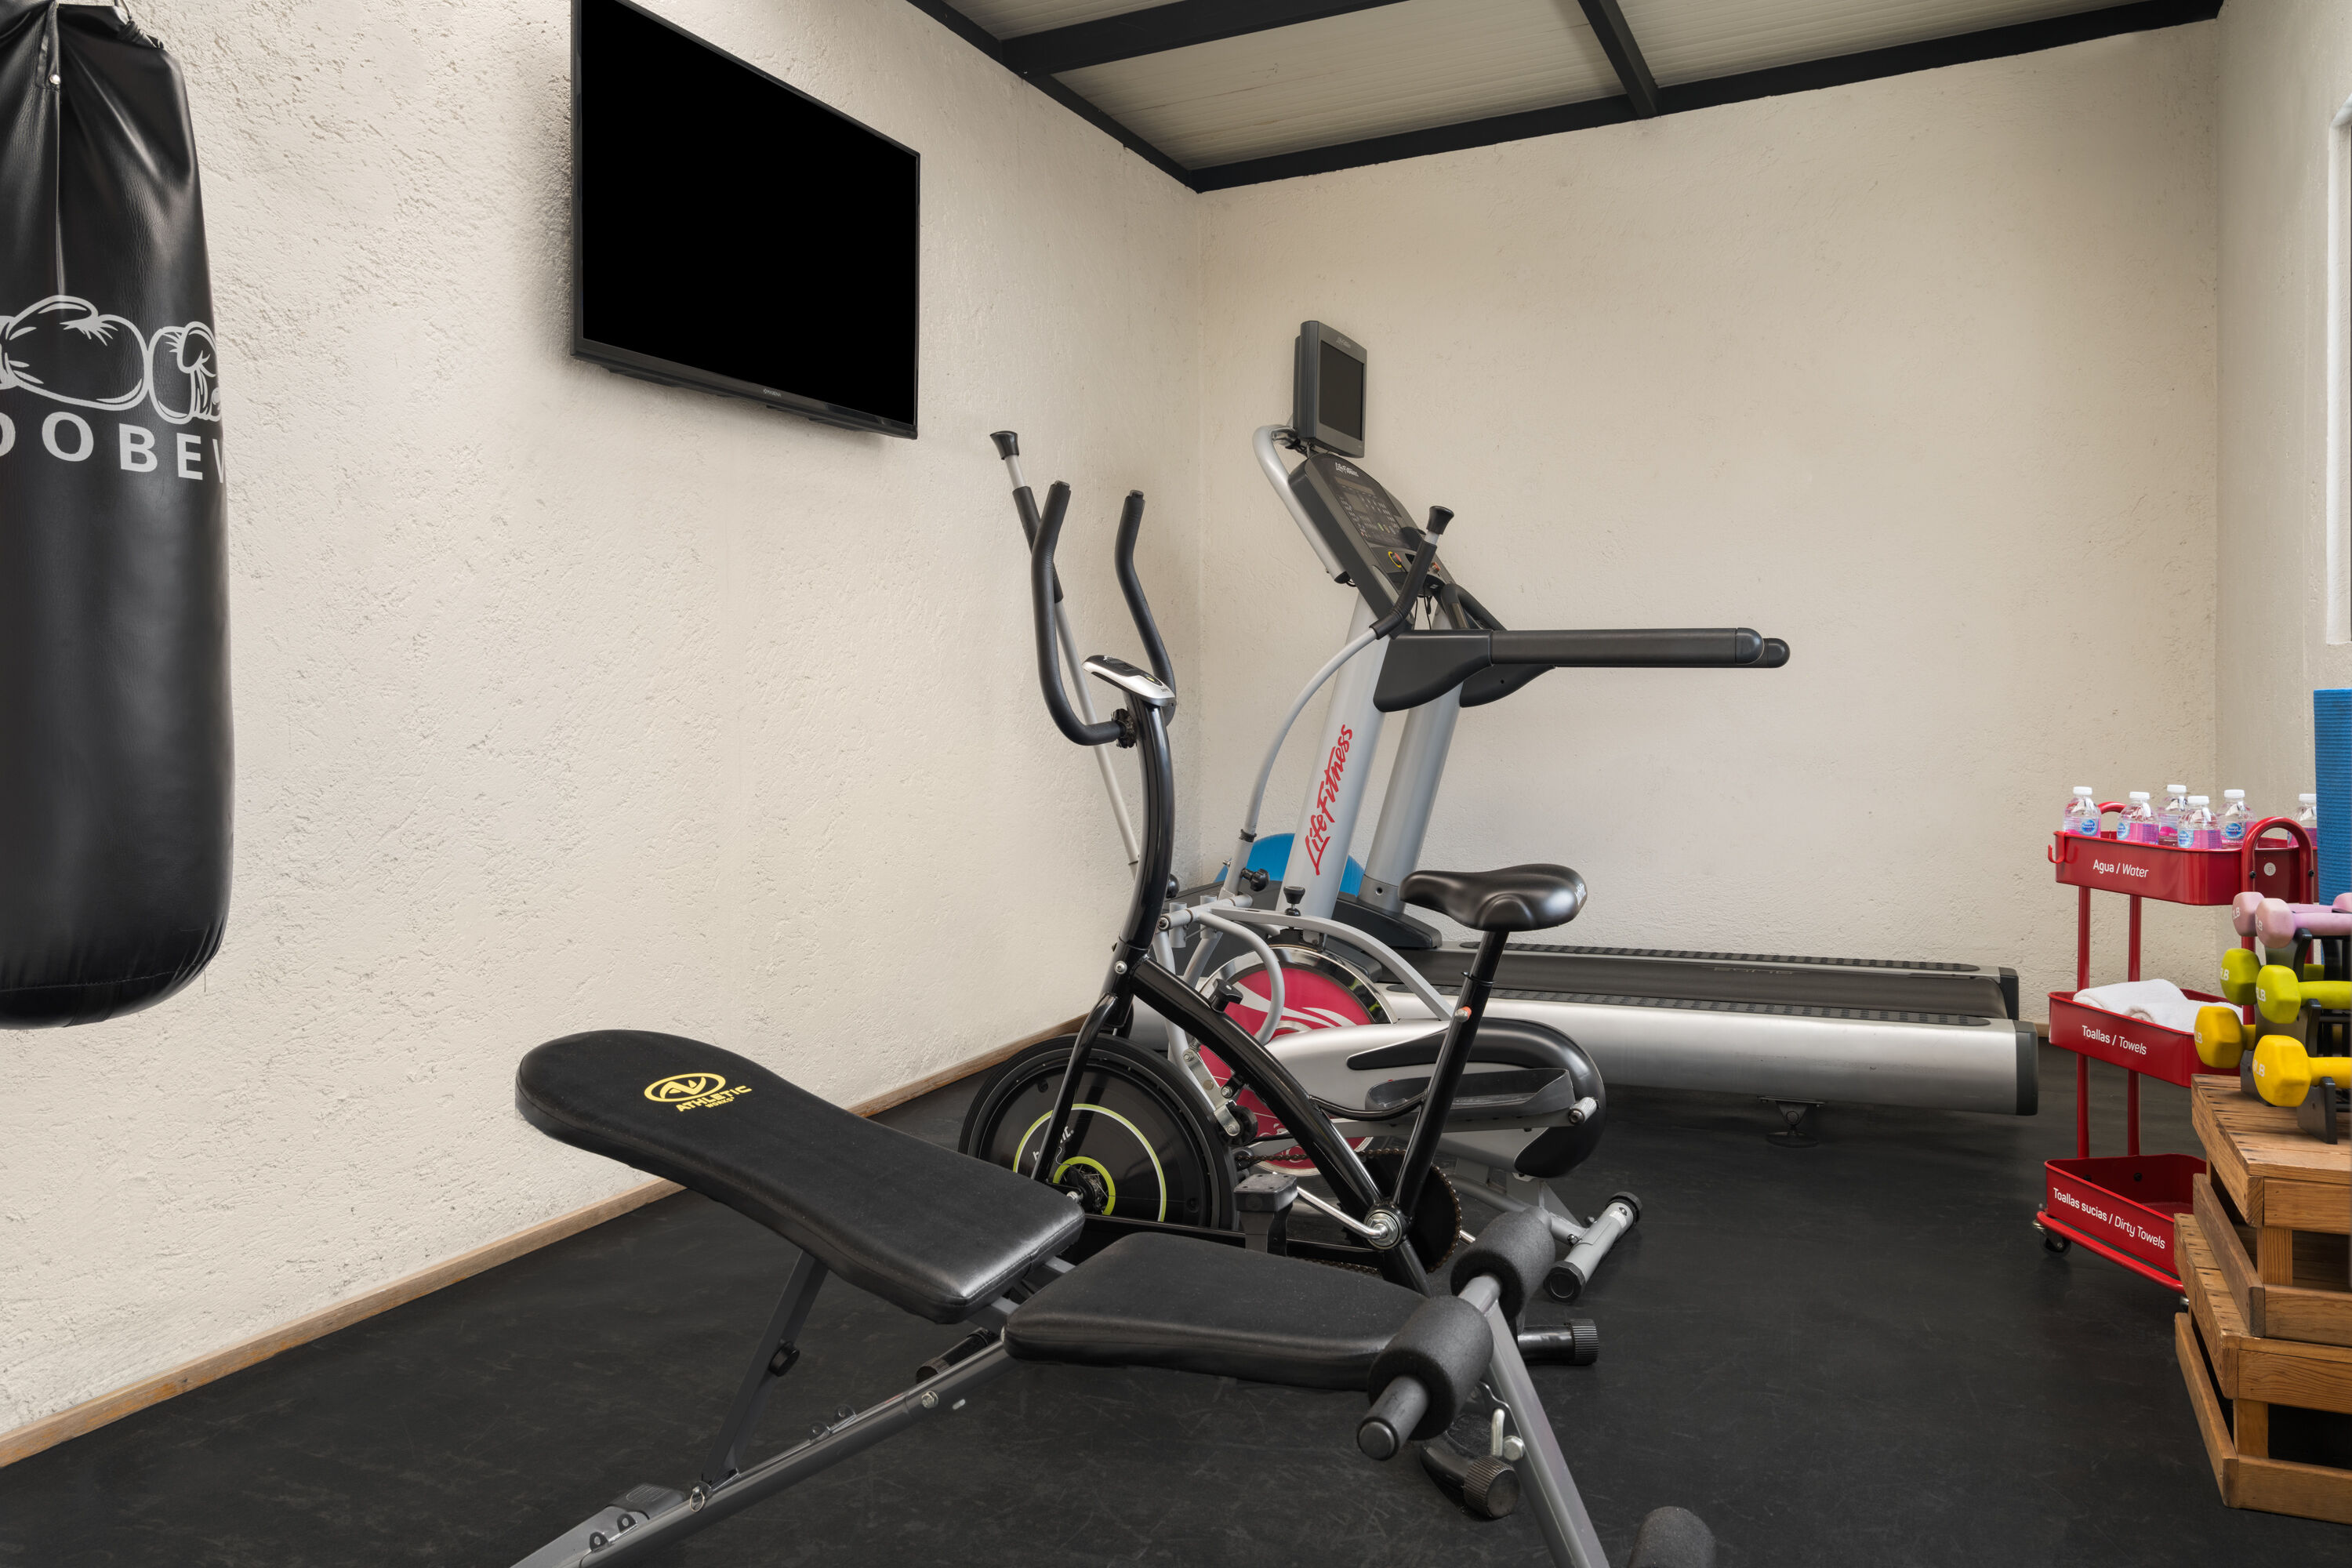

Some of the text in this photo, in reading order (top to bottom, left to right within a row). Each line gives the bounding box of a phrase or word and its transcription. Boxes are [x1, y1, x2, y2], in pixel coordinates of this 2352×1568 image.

[1305, 724, 1353, 876] Life Fitness
[2092, 858, 2114, 874] Agua
[2115, 862, 2121, 874] /
[2082, 1025, 2147, 1055] Toallas / Towels
[676, 1085, 753, 1112] ATHLETIC
[2053, 1187, 2165, 1250] Toallas sucias / Dirty Towels
